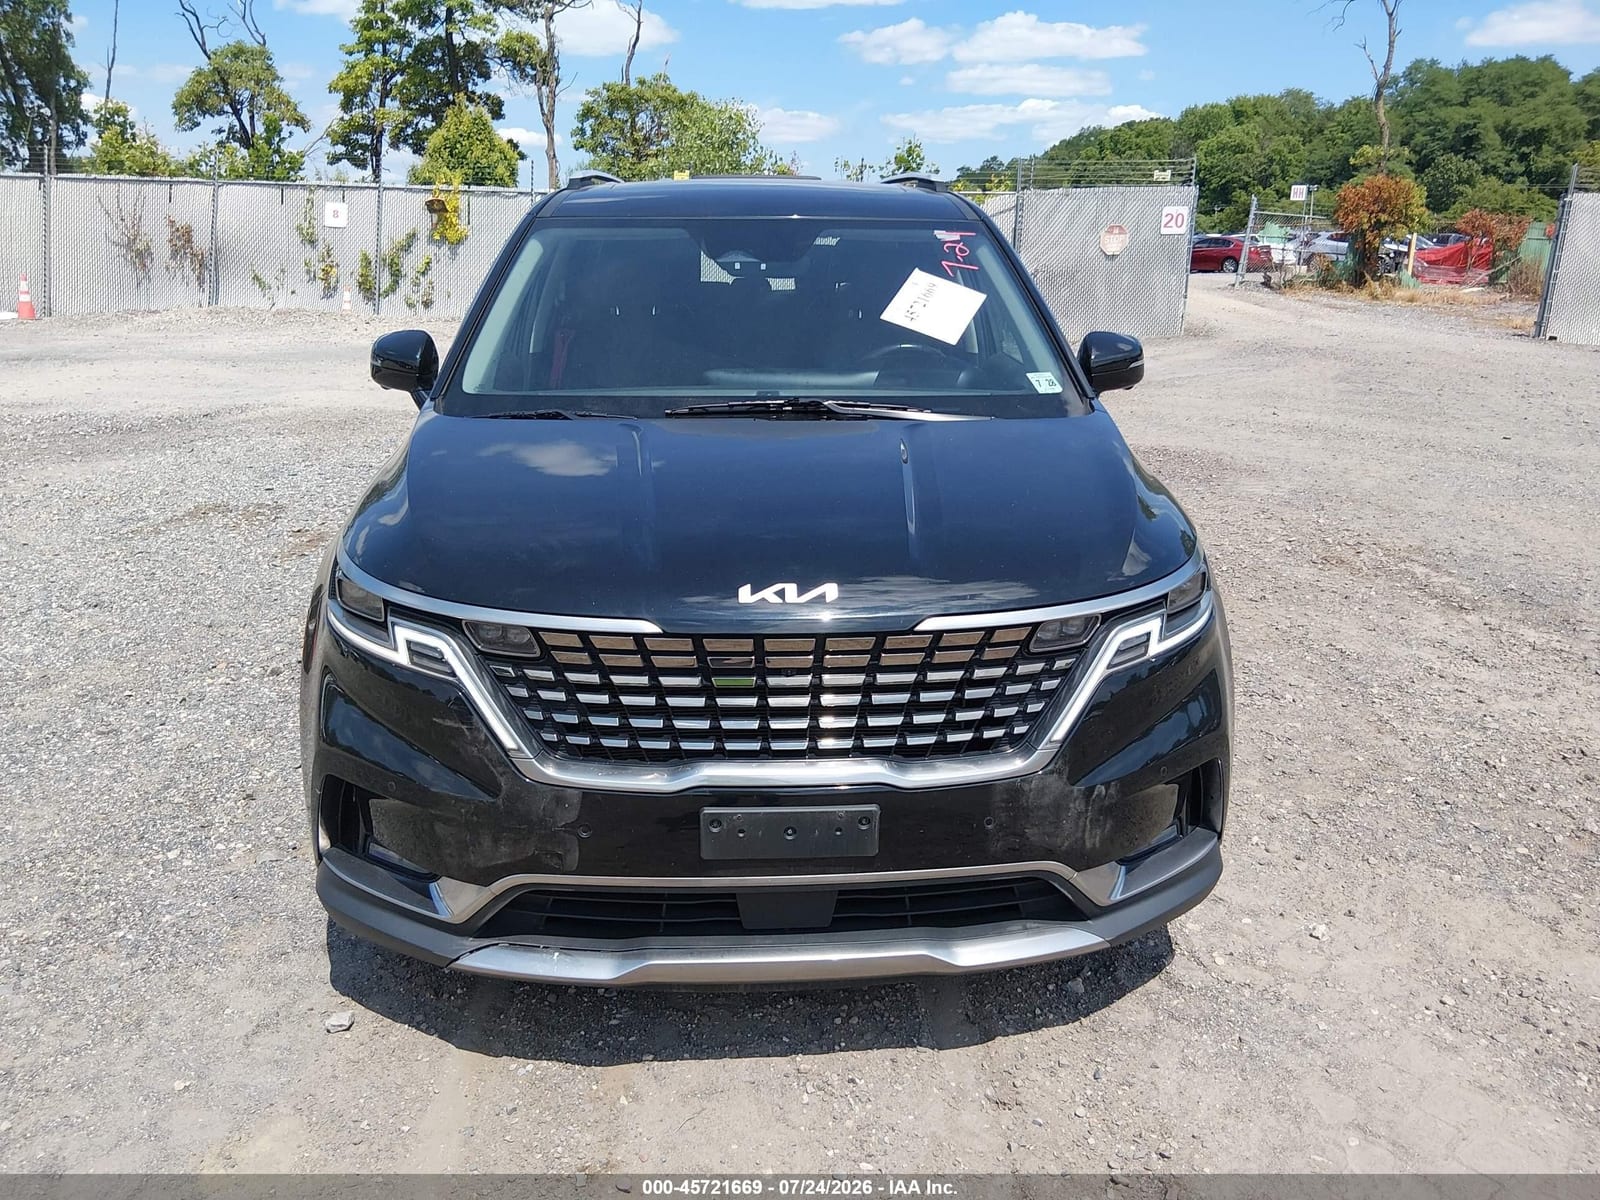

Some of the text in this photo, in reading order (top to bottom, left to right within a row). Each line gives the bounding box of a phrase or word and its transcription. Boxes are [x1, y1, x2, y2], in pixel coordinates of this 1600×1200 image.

[332, 209, 340, 218] 8
[1163, 212, 1185, 229] 20
[738, 582, 839, 604] KIA
